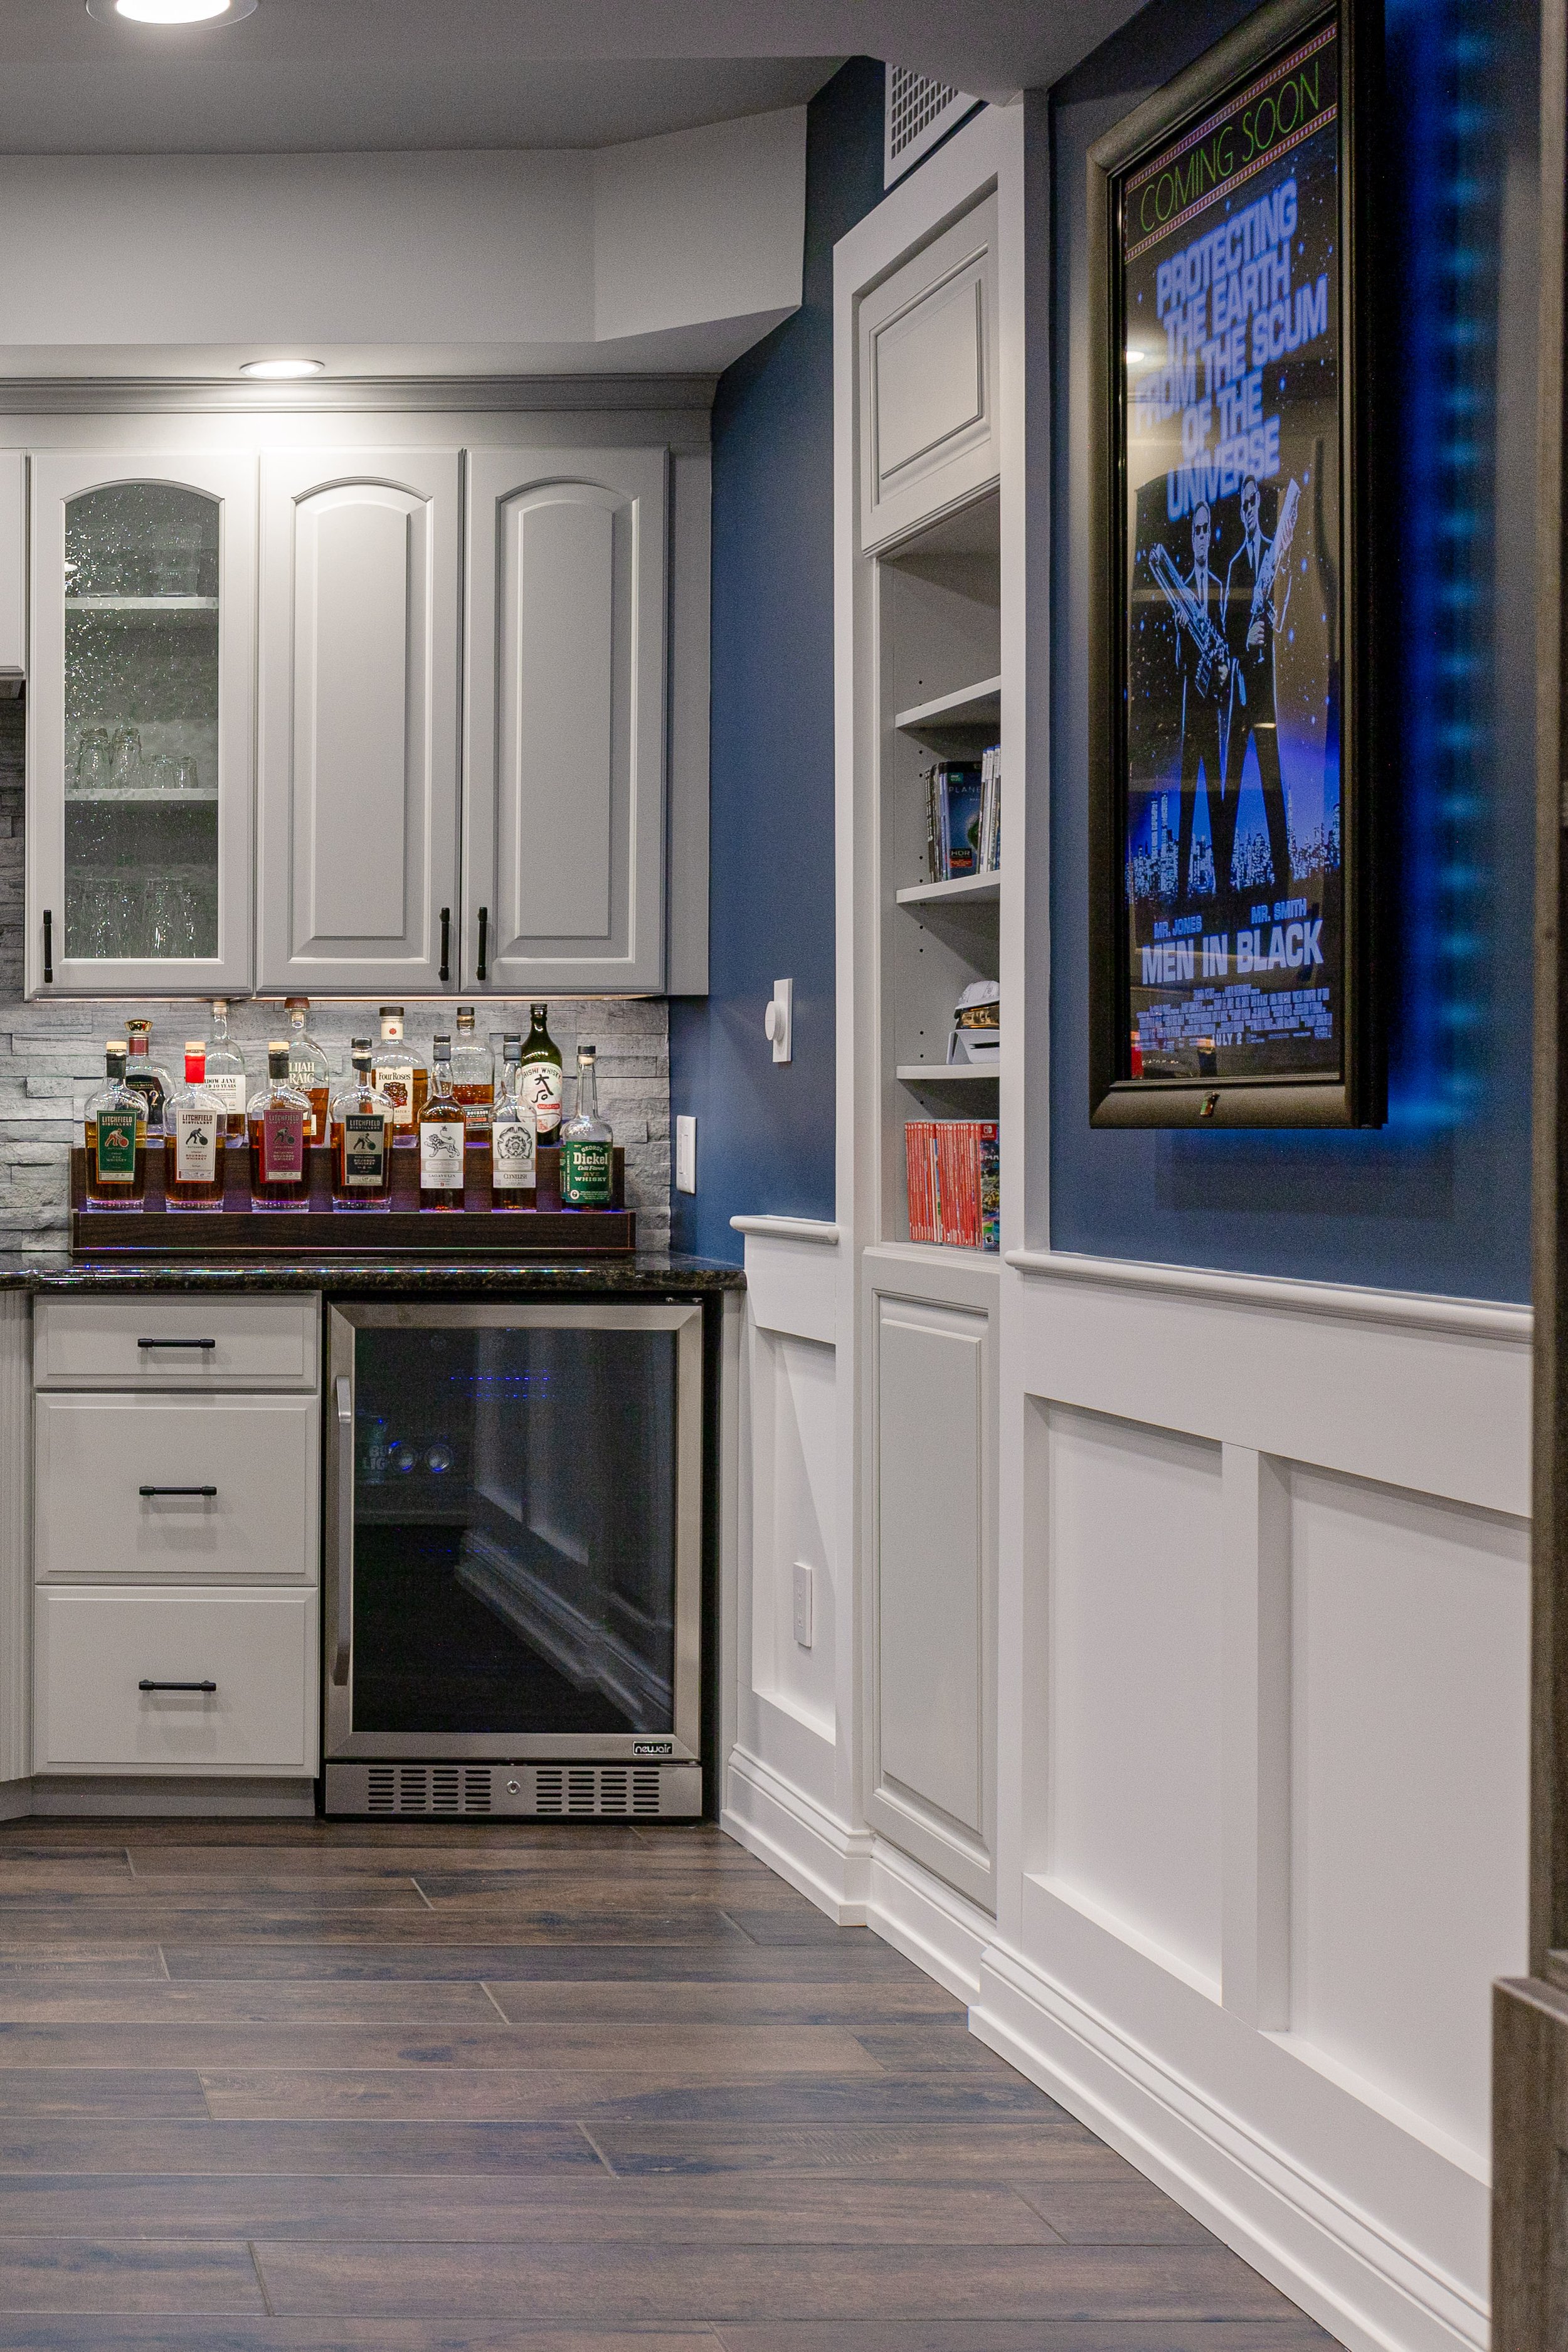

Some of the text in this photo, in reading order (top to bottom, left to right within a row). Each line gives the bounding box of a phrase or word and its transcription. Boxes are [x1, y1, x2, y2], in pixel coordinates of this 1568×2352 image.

[1140, 61, 1319, 232] COMING SOON
[1157, 177, 1298, 318] PROTECTING
[1163, 240, 1291, 364] THE EARTH
[1135, 273, 1329, 436] FROM THE SCUM
[1182, 369, 1264, 461] OF THE
[1167, 415, 1281, 522] UNIVERSE
[1251, 898, 1307, 924] MR. SMITH
[1154, 915, 1202, 940] MR. JONES
[1142, 919, 1324, 985] MEN IN BLACK
[1211, 1032, 1234, 1047] JULY
[1236, 1032, 1242, 1045] 2
[289, 1062, 315, 1073] LIJAH
[289, 1073, 315, 1085] RAIG
[379, 1072, 411, 1080] Four Roses
[541, 1067, 561, 1079] WHISKY
[573, 1152, 608, 1165] Dickel
[635, 1744, 671, 1754] newair
